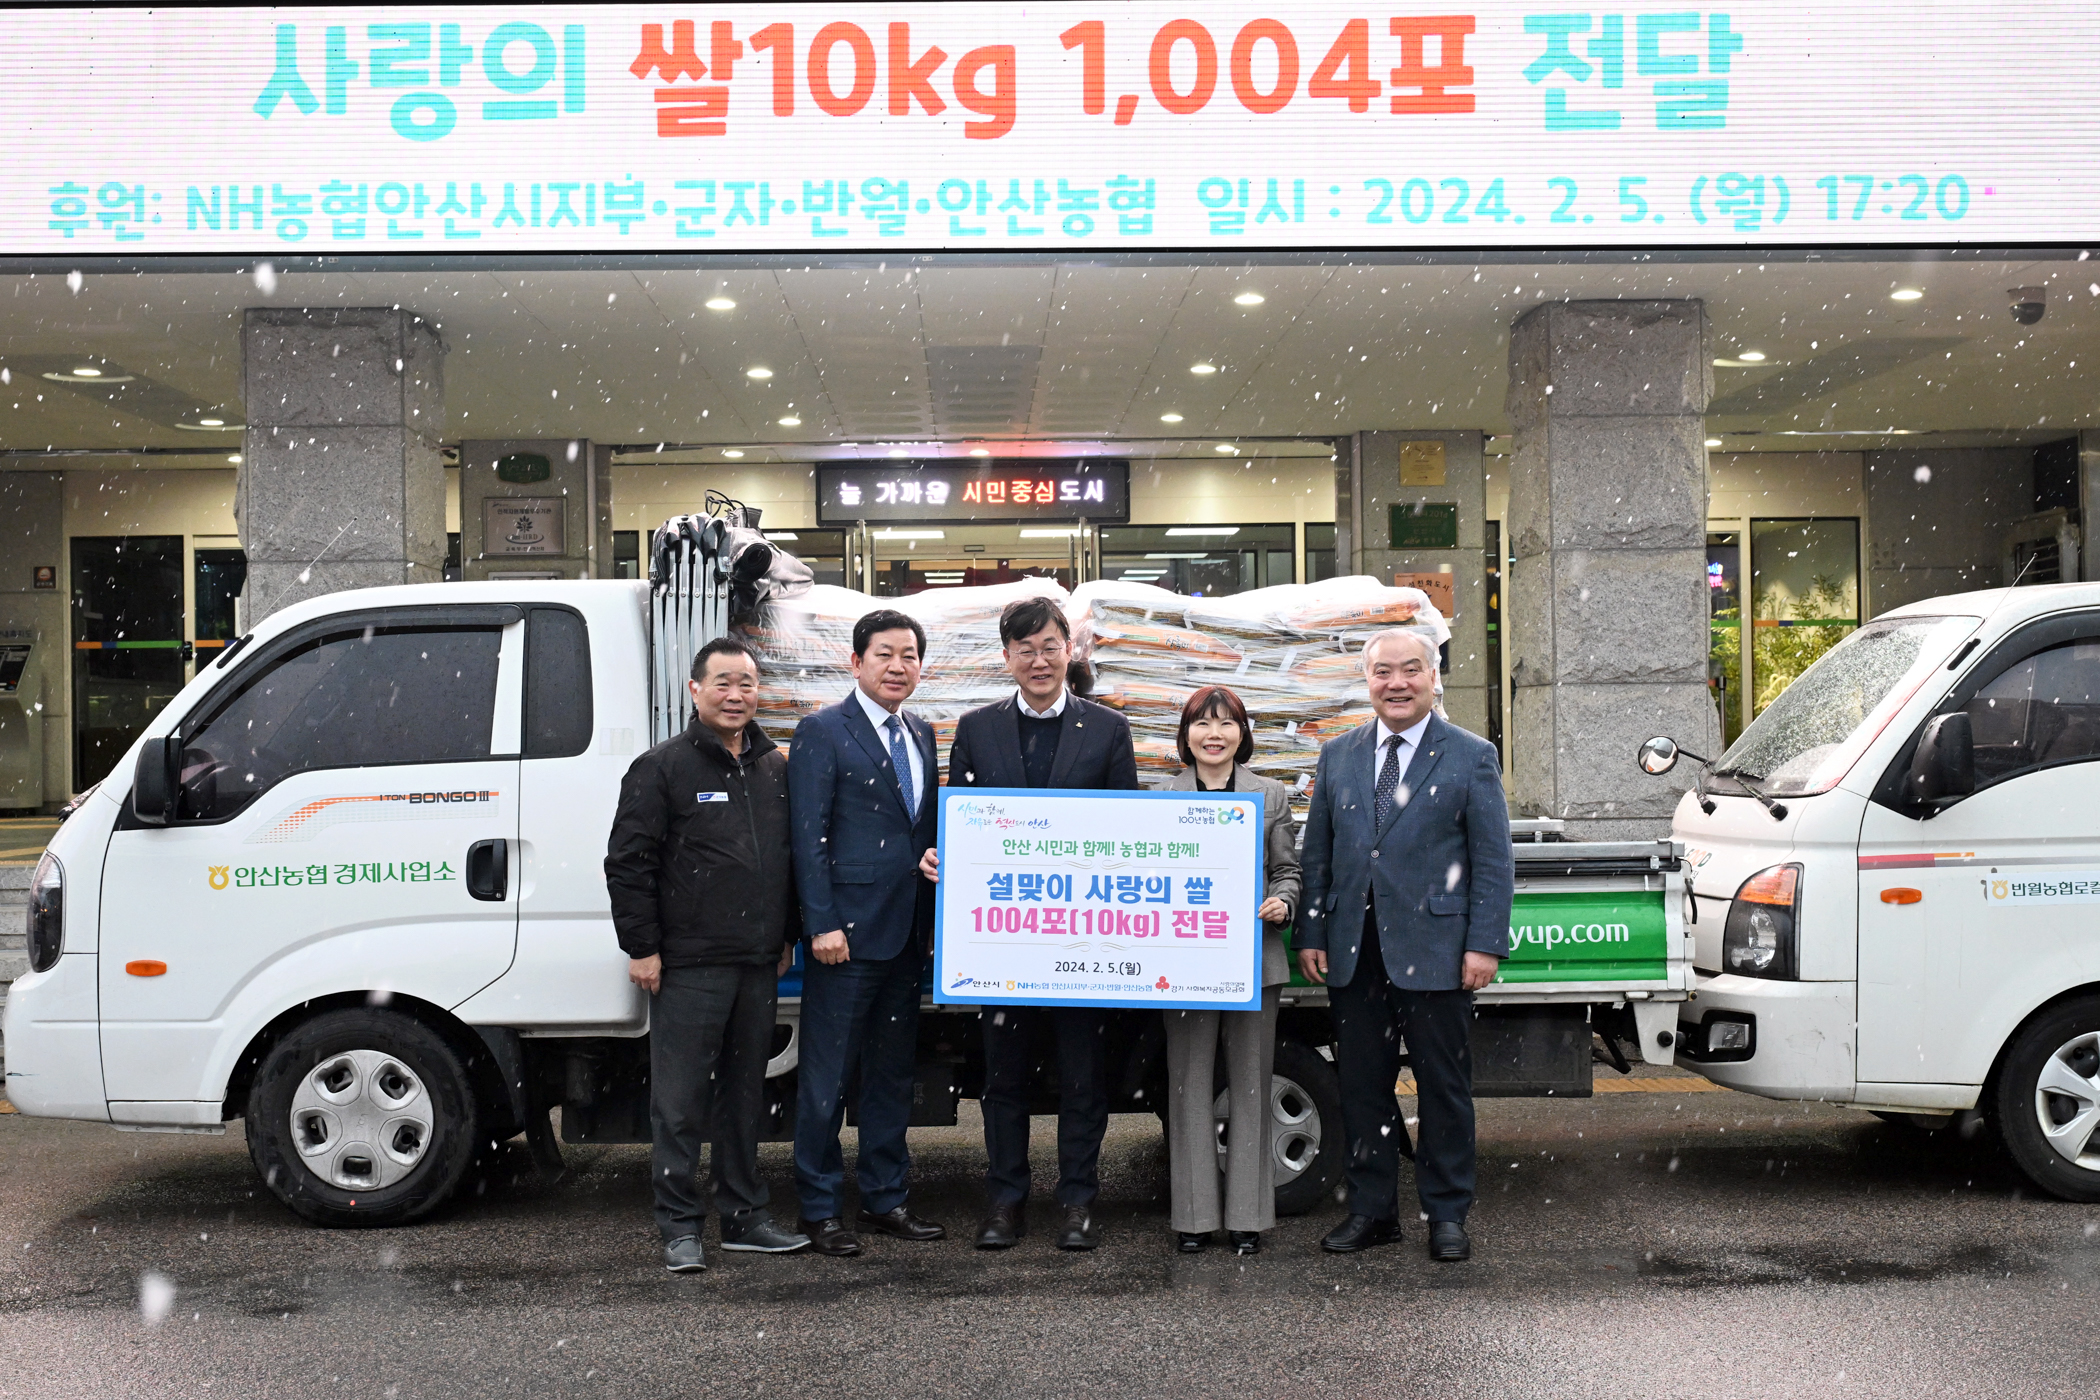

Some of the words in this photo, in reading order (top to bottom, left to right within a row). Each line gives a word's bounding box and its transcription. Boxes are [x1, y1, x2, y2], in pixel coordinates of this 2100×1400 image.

[254, 21, 586, 142] 사랑의
[629, 20, 1017, 139] 쌀10kg
[1060, 14, 1476, 126] 1,004포
[1523, 12, 1744, 132] 전달
[48, 181, 162, 242] 후원:
[1198, 176, 1306, 236] 일시
[1363, 177, 1526, 225] 2024.
[1547, 176, 1594, 224] 2.
[1618, 176, 1666, 224] 5.
[1689, 171, 1791, 232] (월)
[1816, 173, 1971, 221] 17:20
[839, 482, 861, 505] 늘
[409, 791, 477, 804] BONGO
[1187, 806, 1215, 816] 함께하는
[1027, 818, 1053, 830] 안산
[1002, 839, 1032, 857] 안산
[1035, 839, 1080, 857] 시민과
[1082, 840, 1116, 858] 함께!
[1119, 841, 1164, 859] 농협과
[1167, 842, 1200, 859] 함께!
[234, 864, 328, 888] 안산농협
[333, 860, 457, 886] 경제사업소
[986, 872, 1073, 903] 설맞이
[1085, 874, 1172, 905] 사랑의
[1184, 876, 1213, 905] 쌀
[971, 906, 1160, 939] 1004포(10kg)
[1171, 910, 1230, 938] 전달
[1055, 961, 1089, 974] 2024.
[1092, 962, 1104, 974] 2.
